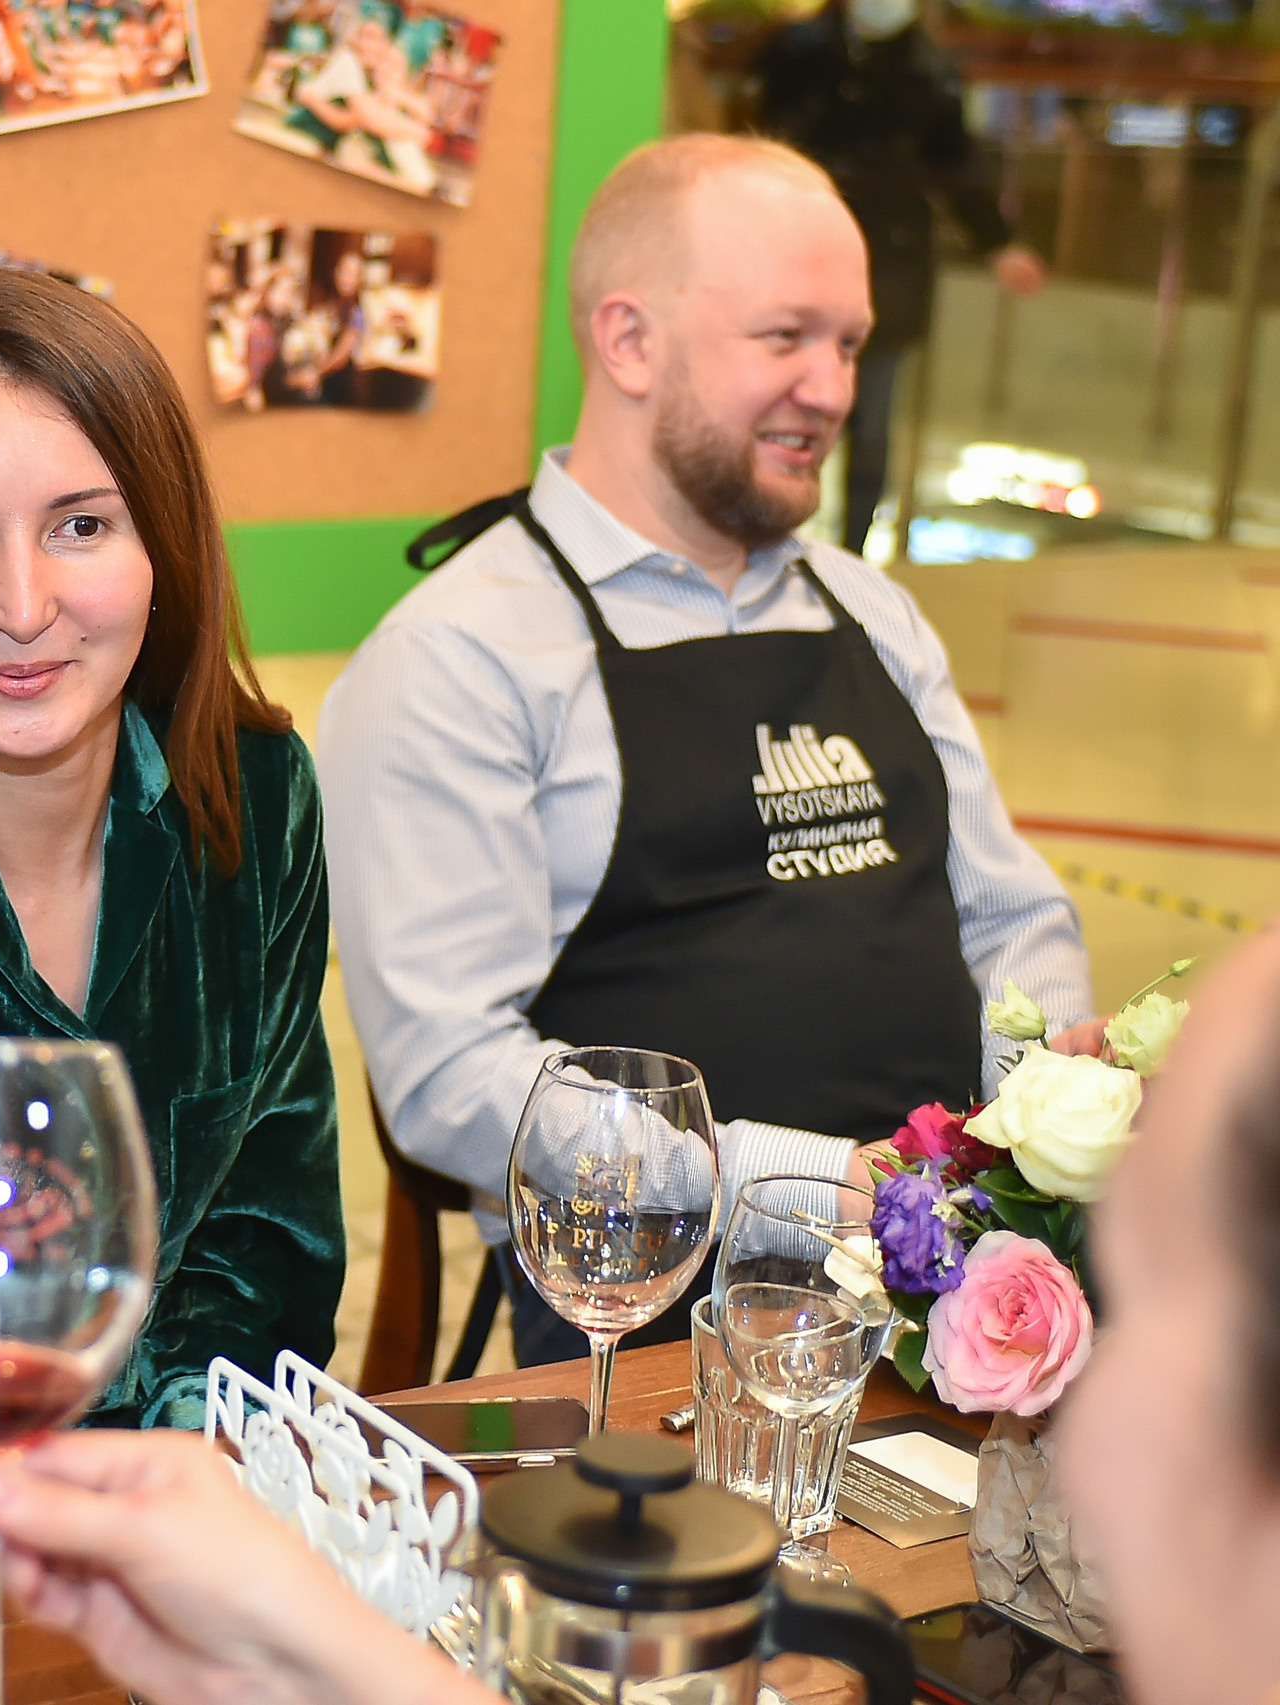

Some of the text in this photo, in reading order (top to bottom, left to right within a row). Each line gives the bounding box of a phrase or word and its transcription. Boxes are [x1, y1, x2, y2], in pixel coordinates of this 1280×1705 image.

[752, 723, 873, 795] Julia
[755, 781, 885, 826] VYSOTSKAYA
[767, 838, 897, 881] СТУДИЯ
